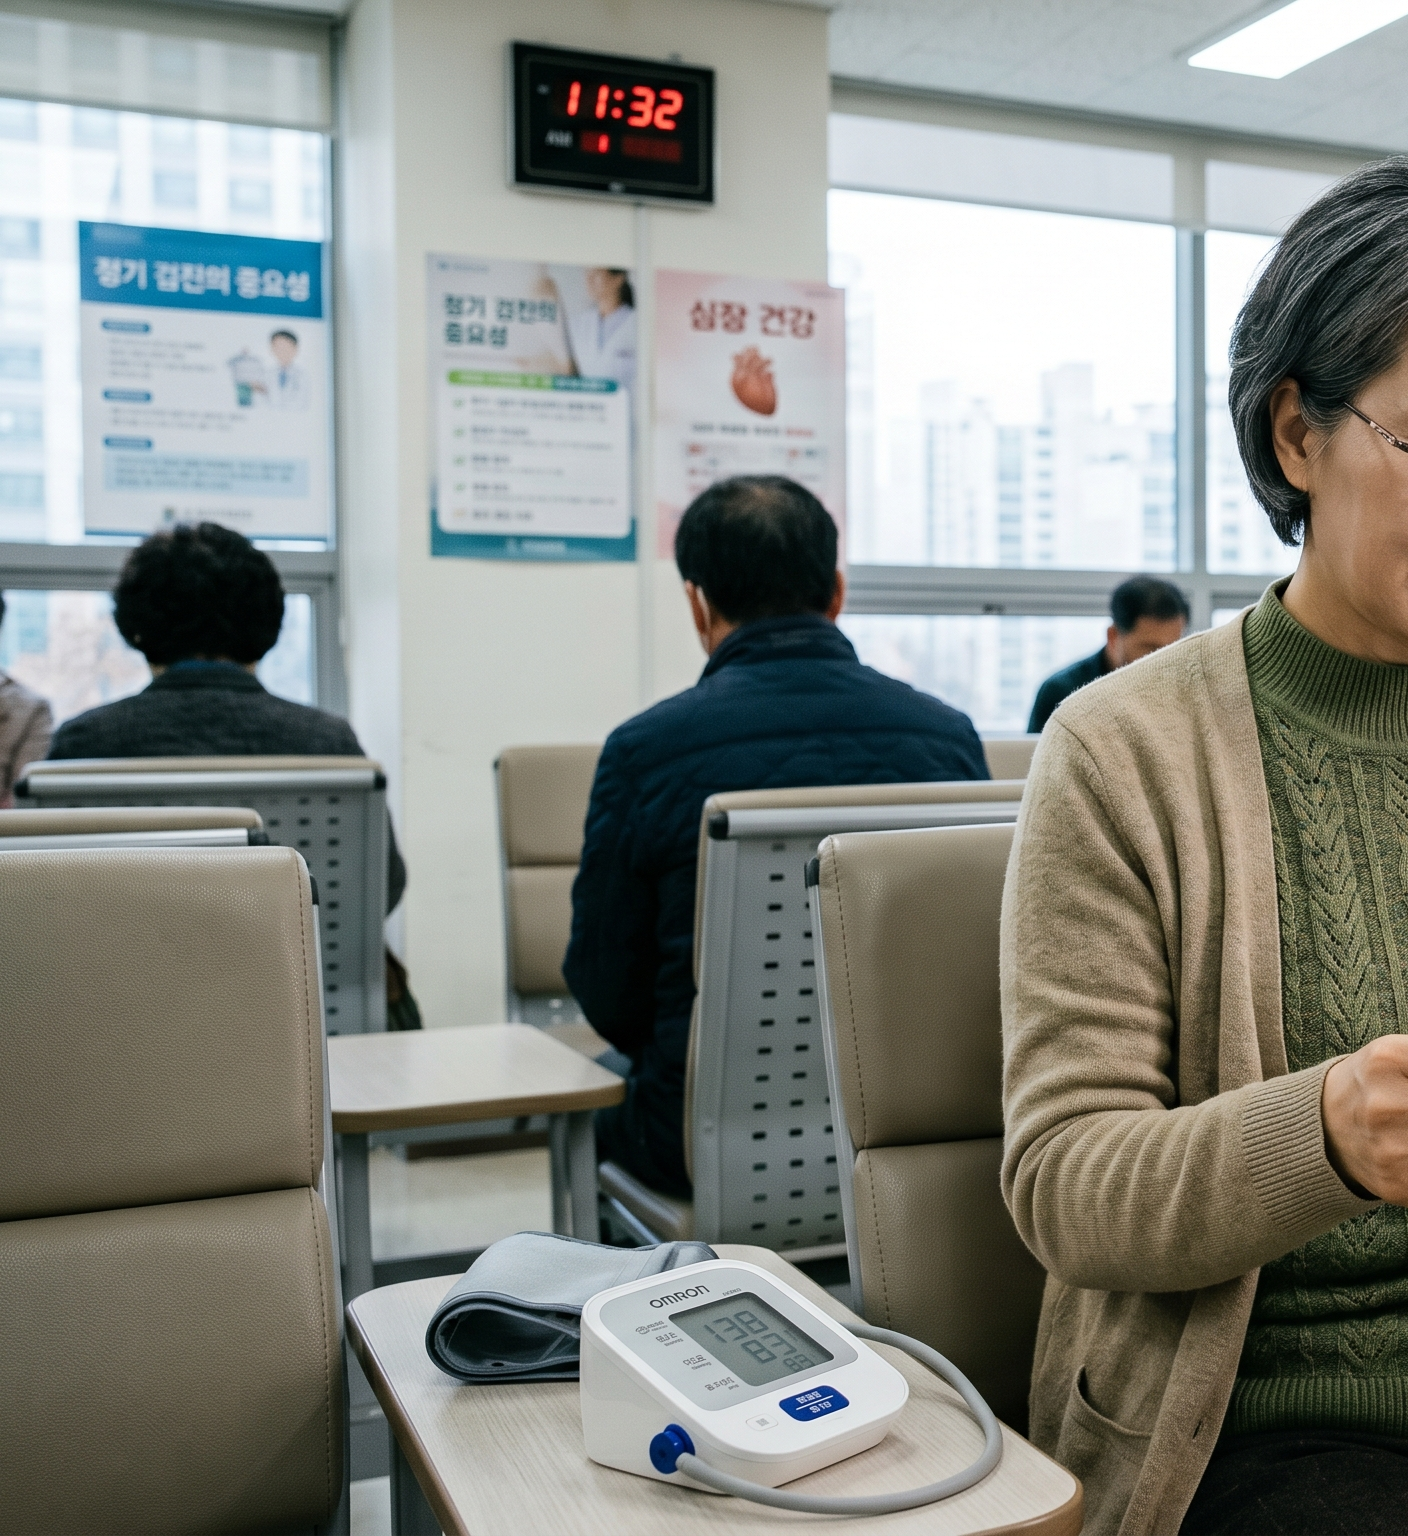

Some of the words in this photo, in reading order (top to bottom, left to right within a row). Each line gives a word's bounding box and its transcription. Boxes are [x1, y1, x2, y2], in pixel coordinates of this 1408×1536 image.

[566, 80, 684, 131] 11:32
[690, 300, 747, 334] 심장
[759, 304, 815, 339] 건강
[649, 1285, 711, 1309] OMRON
[703, 1310, 769, 1343] 138
